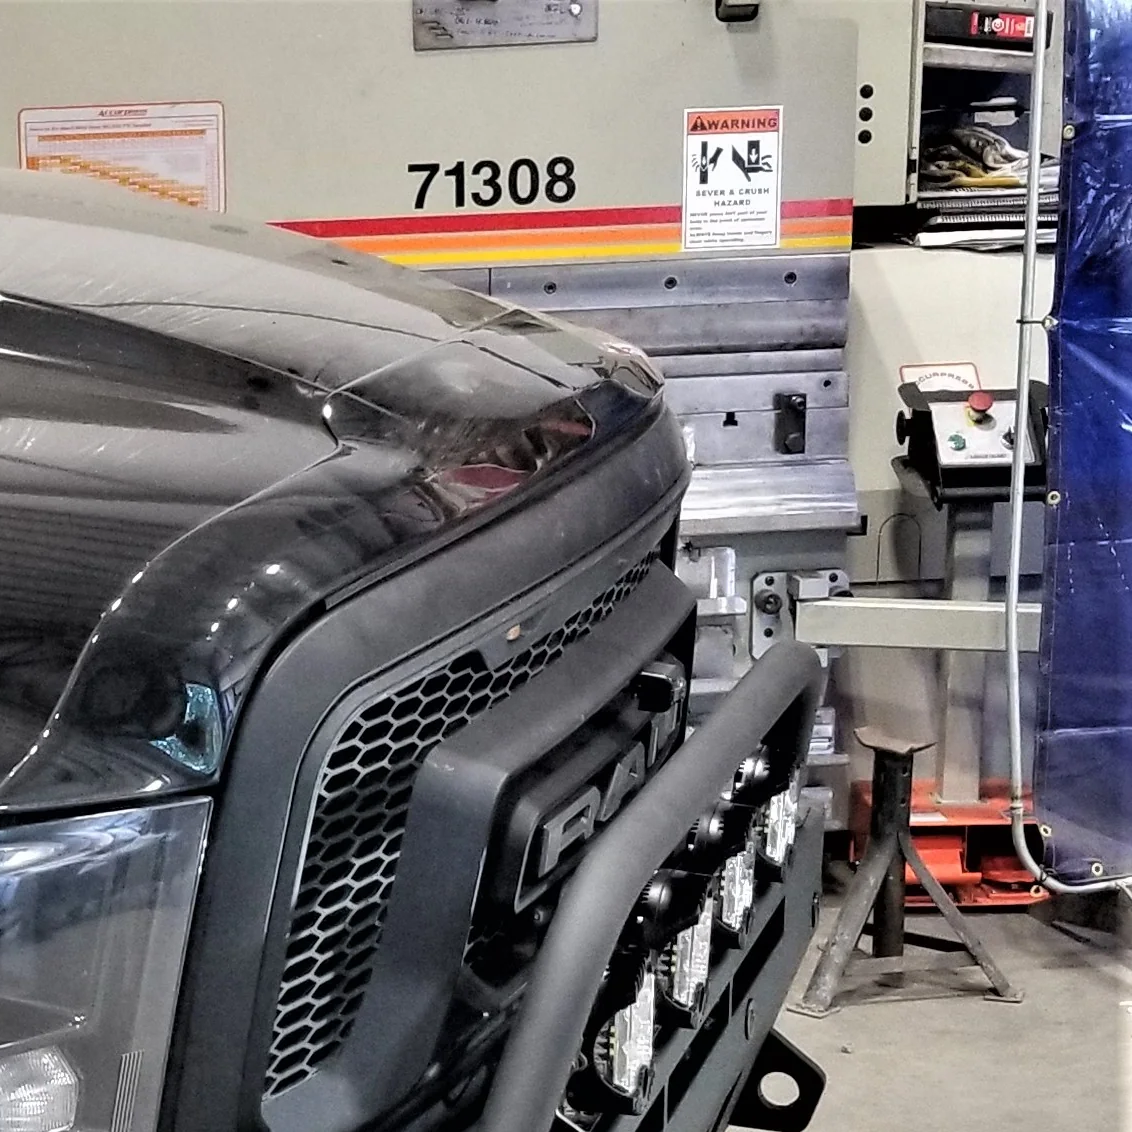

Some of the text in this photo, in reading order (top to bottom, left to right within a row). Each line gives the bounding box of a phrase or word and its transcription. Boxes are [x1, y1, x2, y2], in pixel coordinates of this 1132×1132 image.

[707, 118, 777, 130] WARNING
[408, 156, 576, 209] 71308
[696, 189, 726, 197] SEVER
[739, 187, 770, 195] CRUSH
[714, 199, 751, 207] HAZARD
